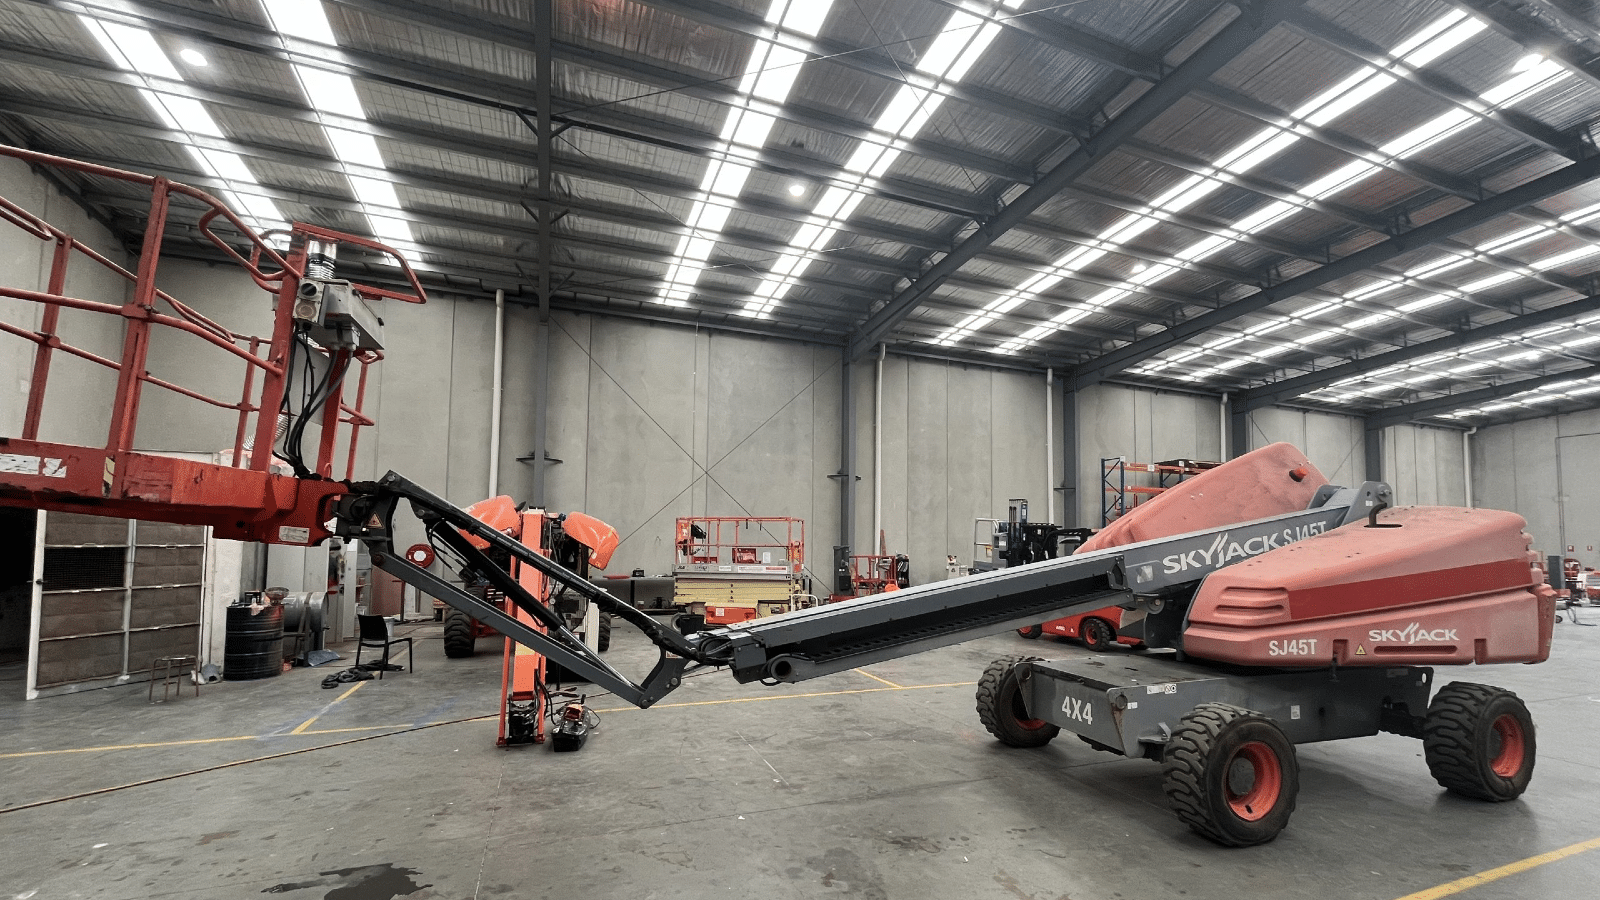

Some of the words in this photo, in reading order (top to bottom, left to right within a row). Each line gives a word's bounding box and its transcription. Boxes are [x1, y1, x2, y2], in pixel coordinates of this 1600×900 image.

[1162, 532, 1282, 574] SKYJACK
[1283, 521, 1327, 545] SJ45T
[1368, 622, 1460, 645] SKYJACK
[1268, 638, 1318, 656] SJ45T
[1061, 695, 1093, 725] 4X4
